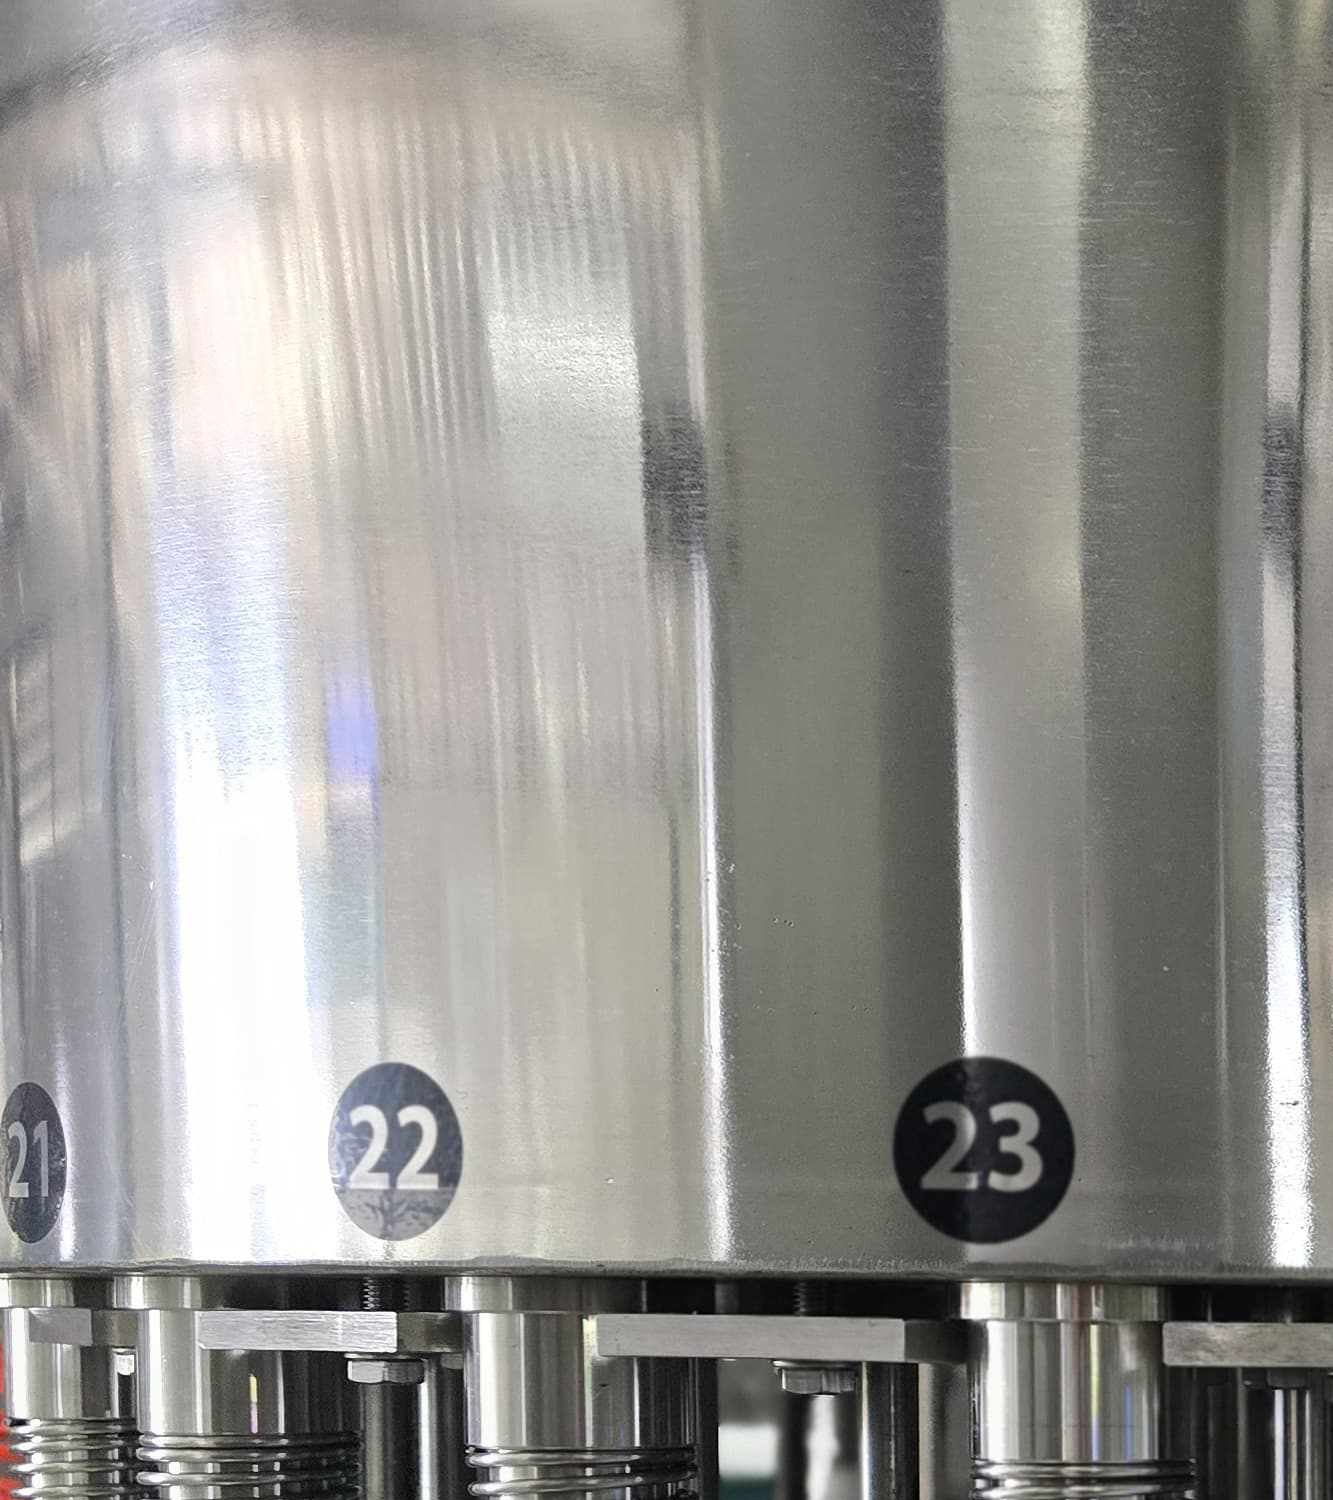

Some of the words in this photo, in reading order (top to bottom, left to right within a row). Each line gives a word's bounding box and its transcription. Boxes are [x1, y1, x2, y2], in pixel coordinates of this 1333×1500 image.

[7, 1120, 49, 1198] 21
[349, 1104, 439, 1189] 22
[920, 1101, 1043, 1192] 23
